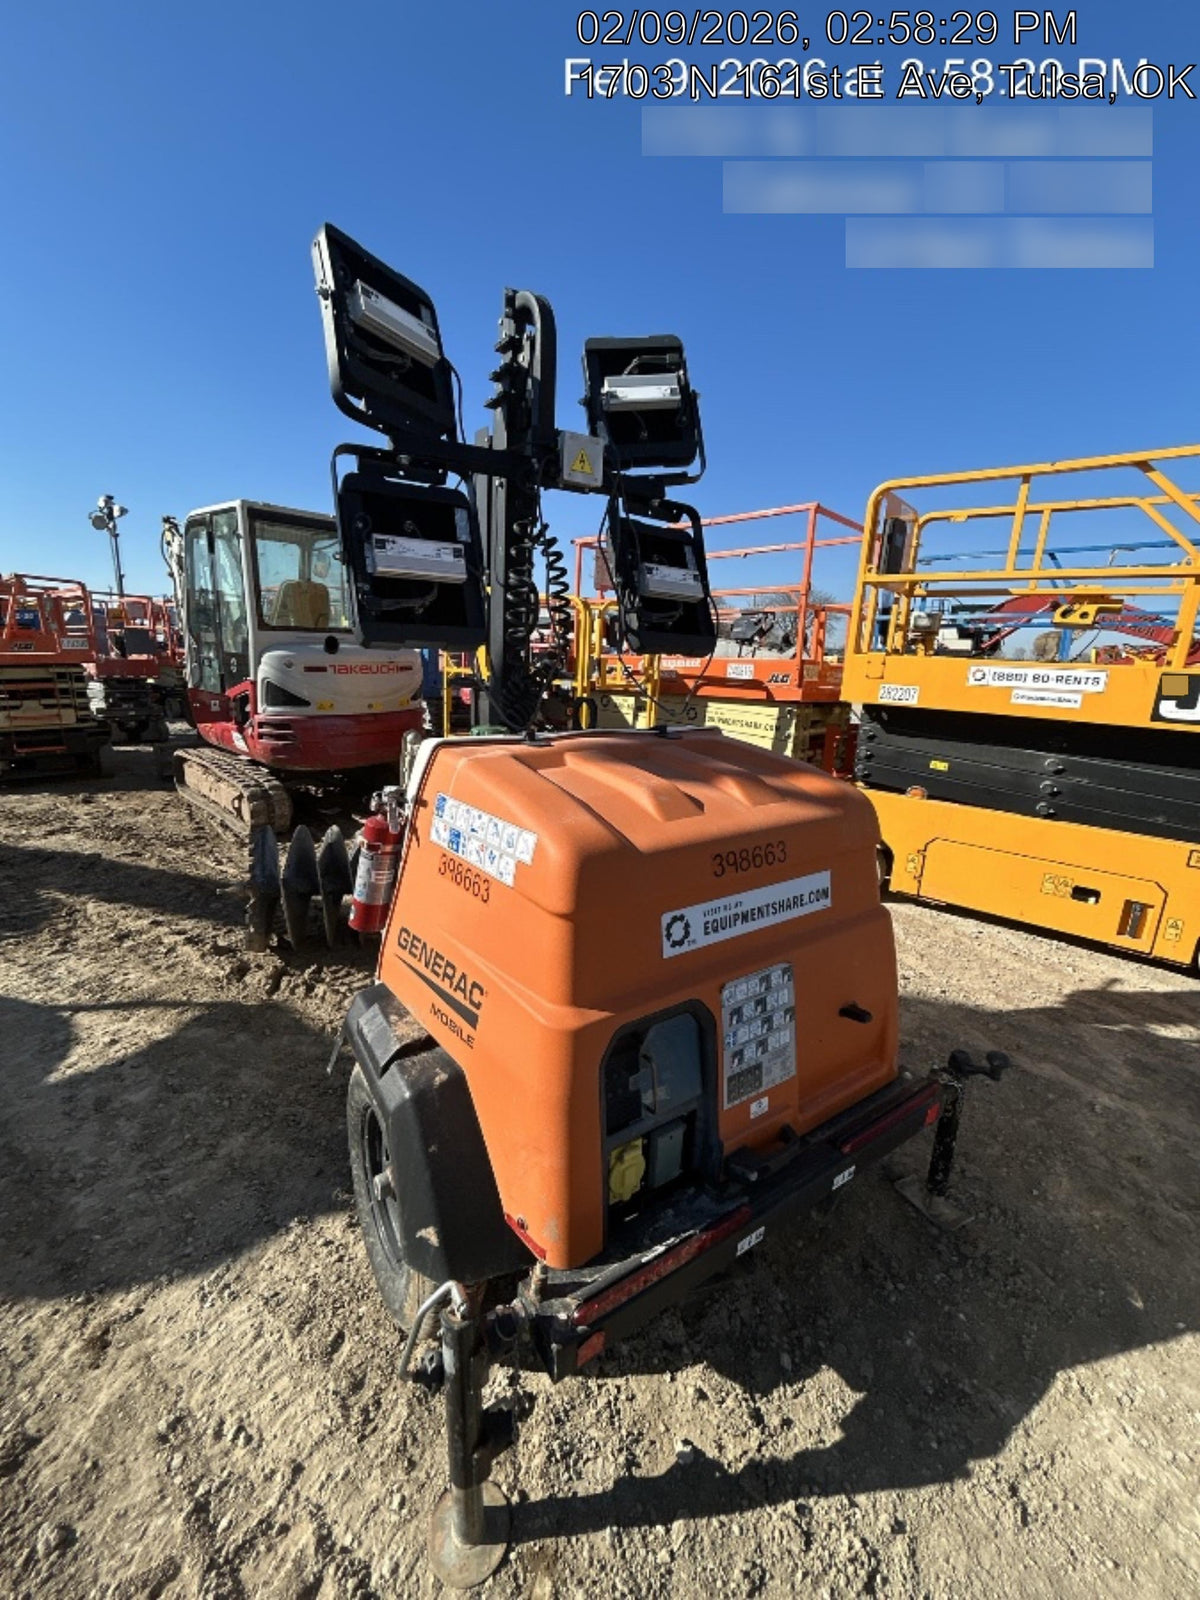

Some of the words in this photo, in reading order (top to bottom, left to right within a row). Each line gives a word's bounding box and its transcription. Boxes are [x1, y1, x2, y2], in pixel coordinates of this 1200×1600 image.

[768, 672, 791, 684] JLG
[438, 853, 490, 903] 398663
[712, 839, 787, 878] 398663
[703, 886, 830, 936] EQUIPMENTSHARE.COM
[397, 926, 485, 1011] GENERAC
[429, 1003, 476, 1050] MOBILE
